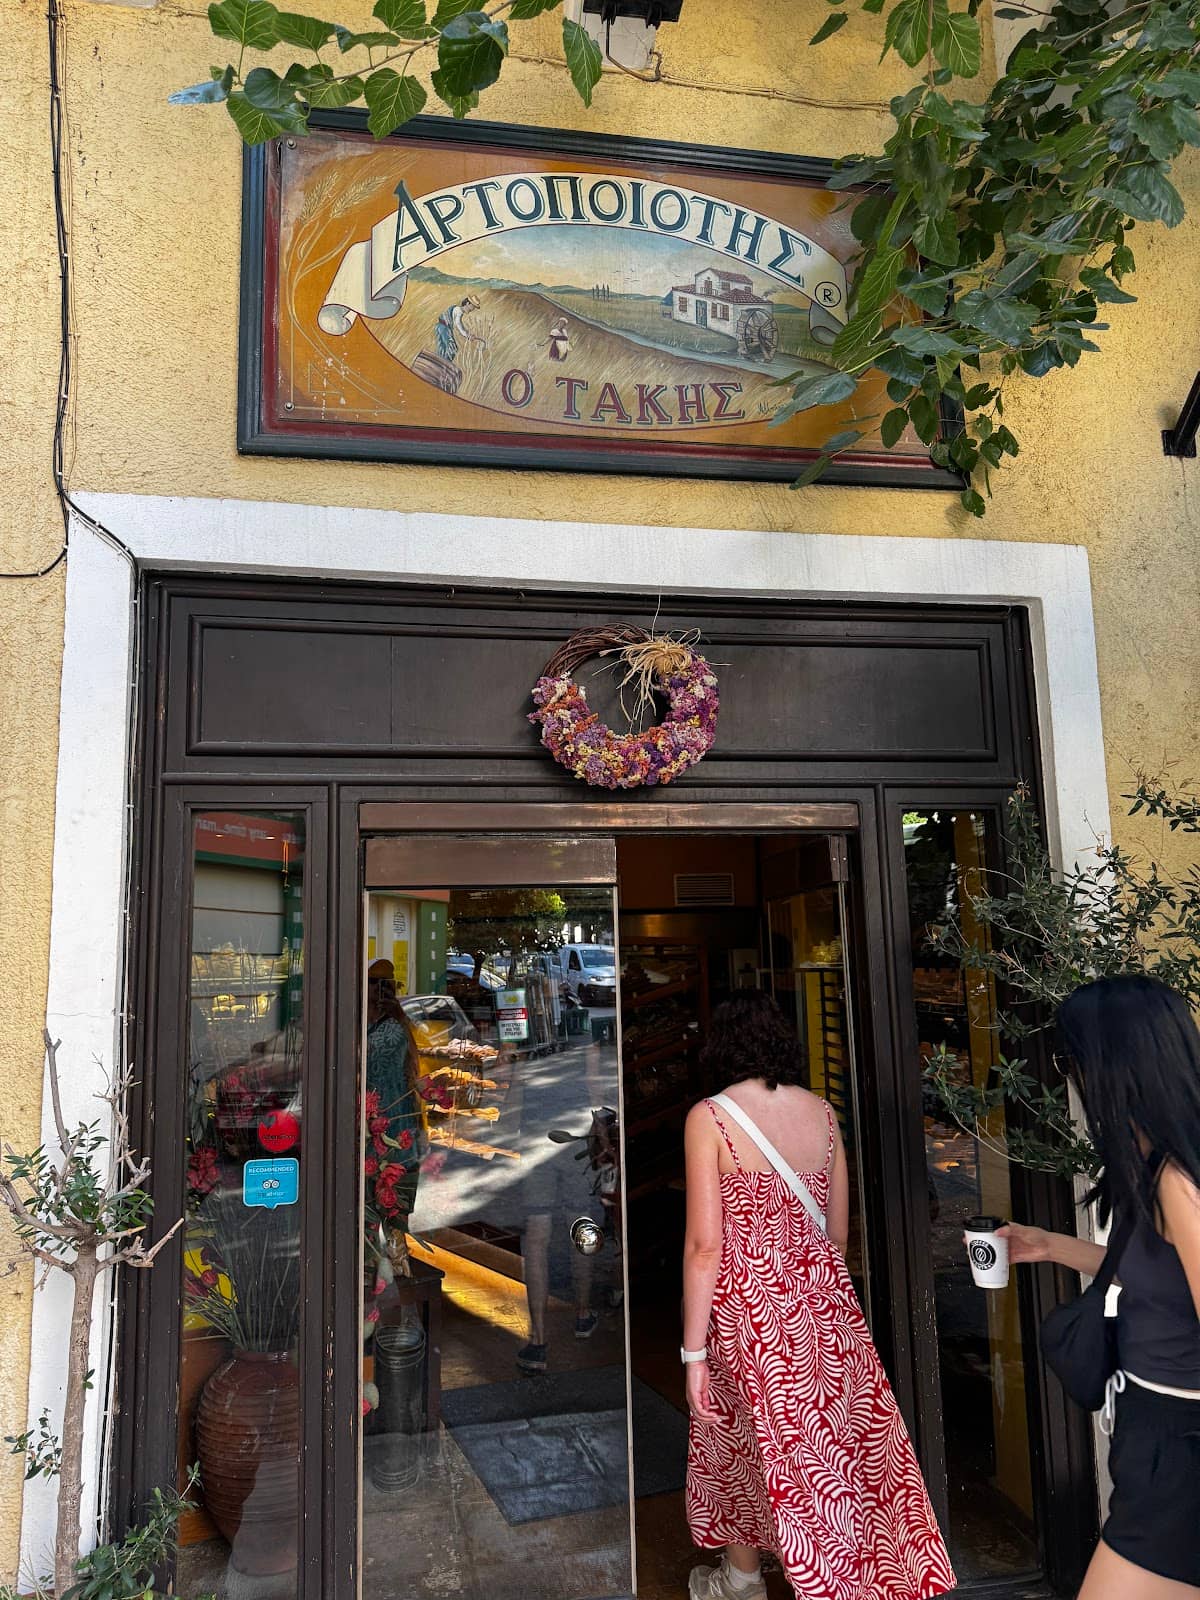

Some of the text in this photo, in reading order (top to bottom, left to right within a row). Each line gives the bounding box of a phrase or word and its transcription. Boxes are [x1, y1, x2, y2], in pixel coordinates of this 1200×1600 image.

[391, 175, 813, 288] ΑΡΤΟΠΟΙΟΤΗΣ
[501, 368, 745, 424] Ο ΤΑΚΗΣ
[248, 1166, 295, 1174] RECOMMENDED
